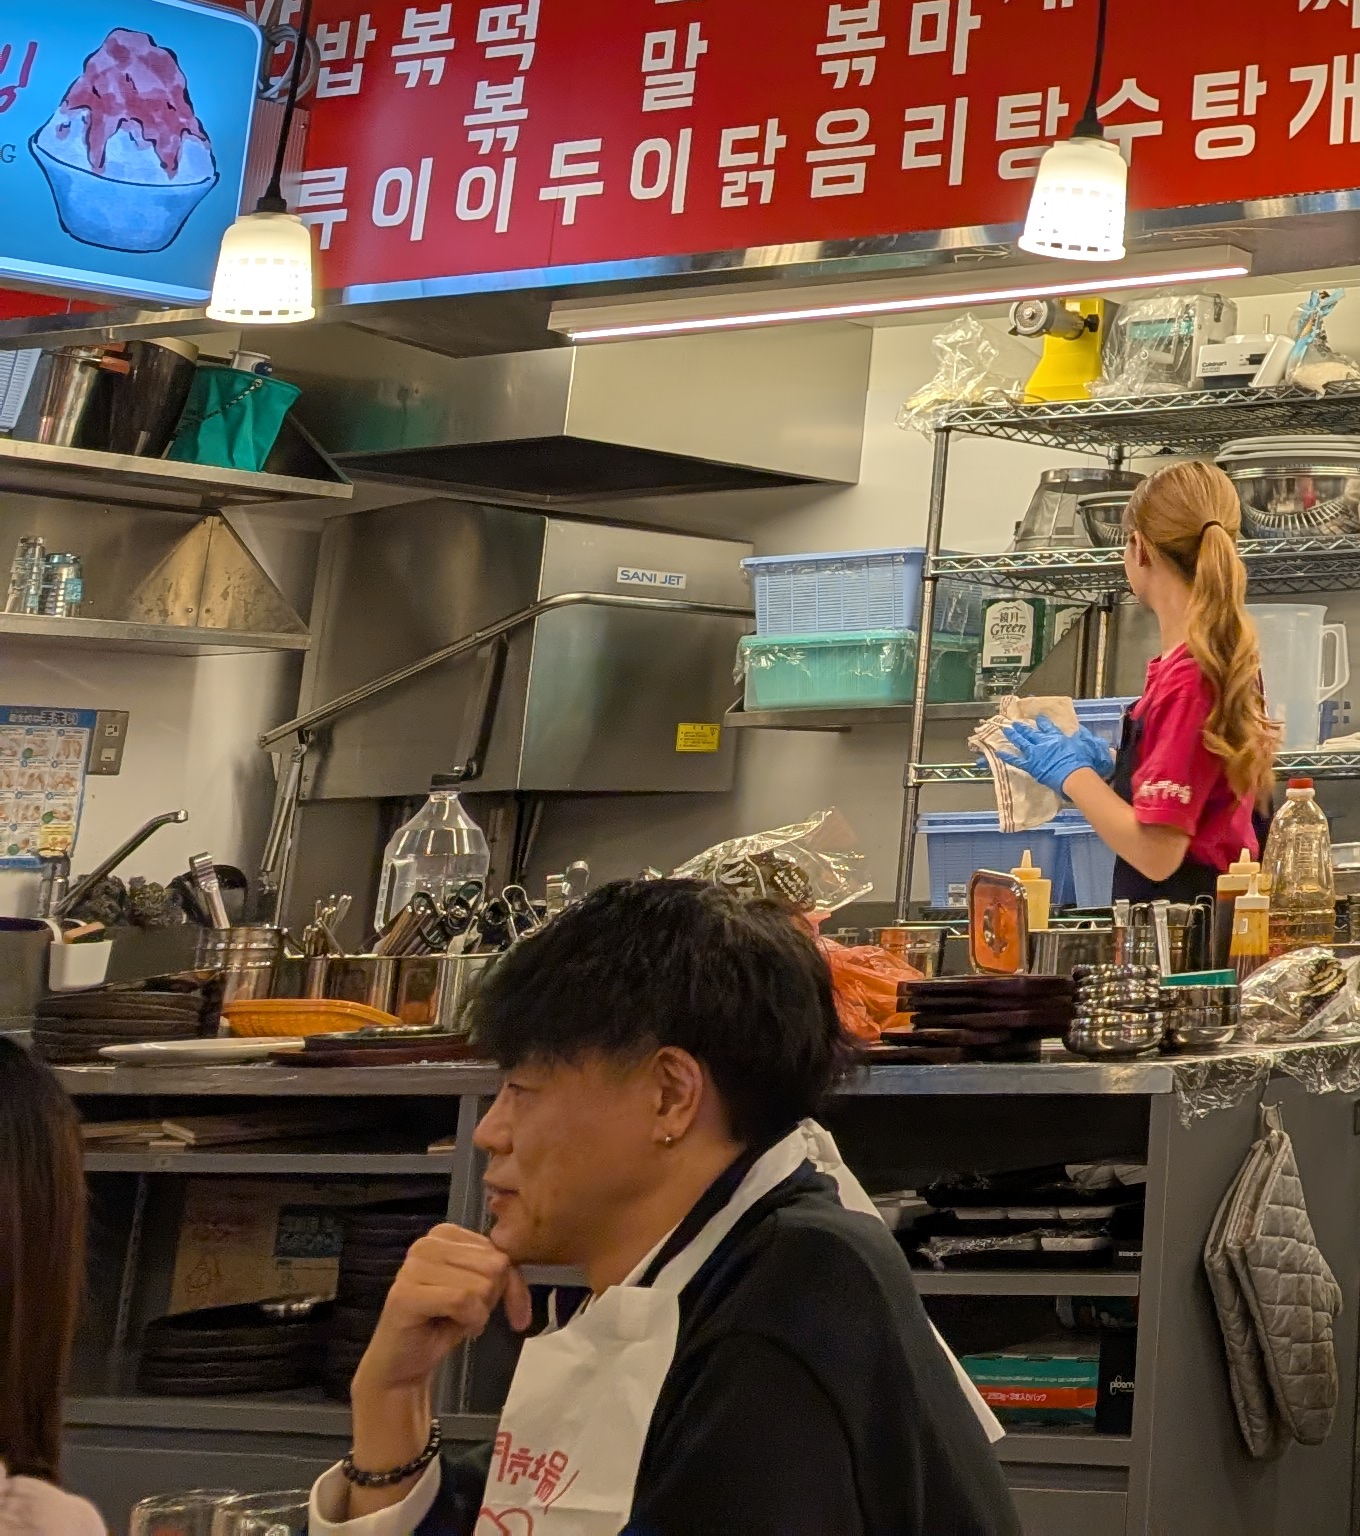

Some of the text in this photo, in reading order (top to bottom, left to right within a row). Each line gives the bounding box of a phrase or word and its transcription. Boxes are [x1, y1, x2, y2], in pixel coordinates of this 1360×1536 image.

[619, 569, 684, 585] SANI JET
[990, 623, 1027, 636] Green
